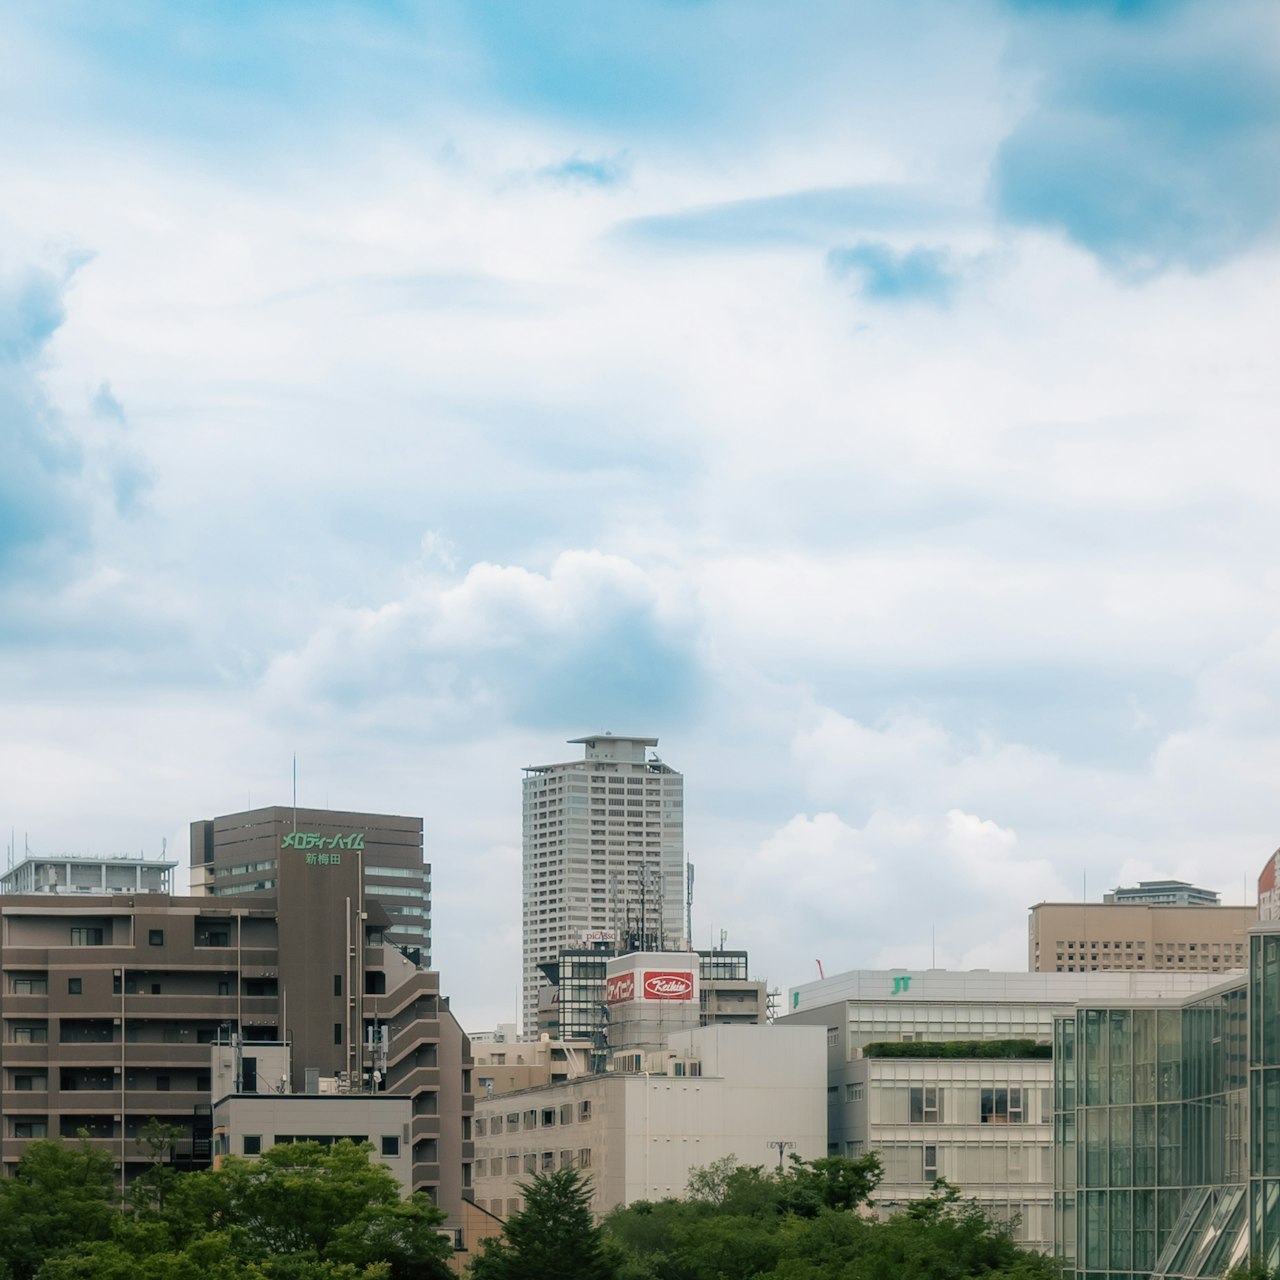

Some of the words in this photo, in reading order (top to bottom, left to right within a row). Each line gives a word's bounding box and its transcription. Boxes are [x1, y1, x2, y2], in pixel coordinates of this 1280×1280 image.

[281, 832, 365, 849] メロディーハイム
[305, 852, 341, 865] 新梅田
[652, 979, 686, 993] Keihin
[890, 976, 912, 995] JT
